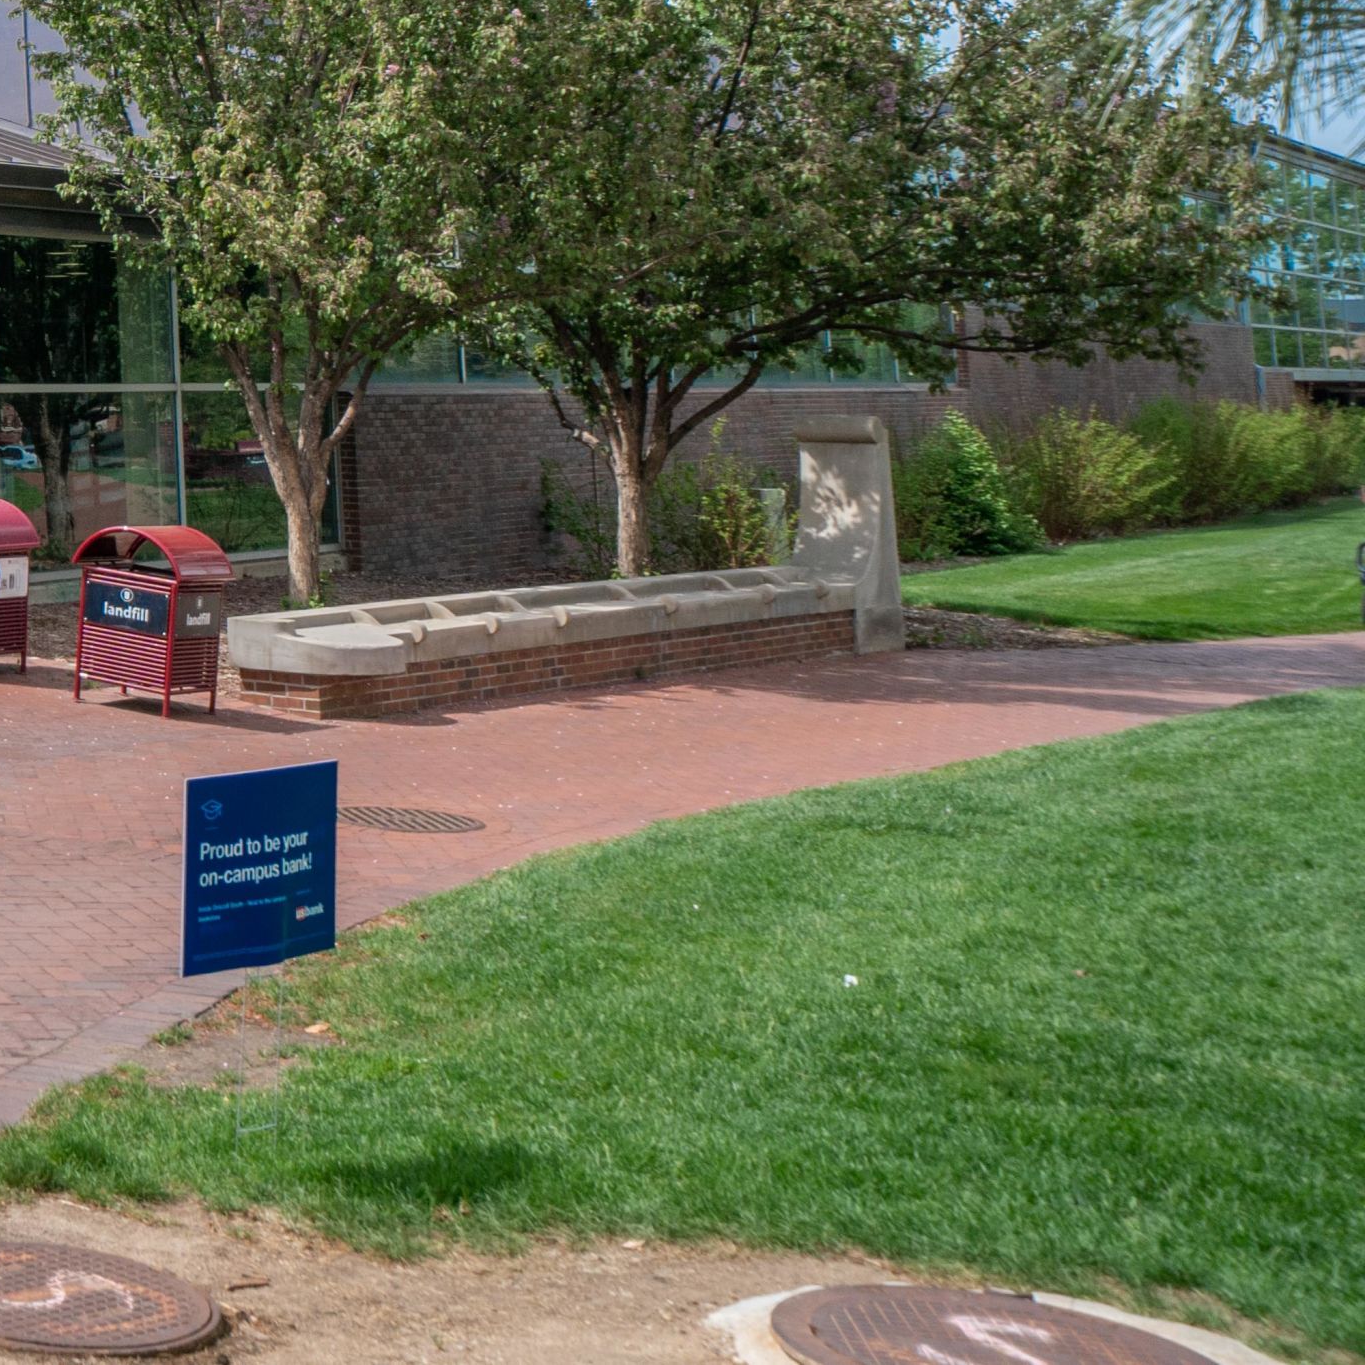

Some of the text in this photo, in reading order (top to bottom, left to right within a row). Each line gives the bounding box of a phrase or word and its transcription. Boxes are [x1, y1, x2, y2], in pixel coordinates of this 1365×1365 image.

[103, 601, 149, 622] landfill
[186, 612, 210, 626] landfill
[199, 831, 308, 861] Proud to be your
[199, 852, 313, 887] on-campus bank!
